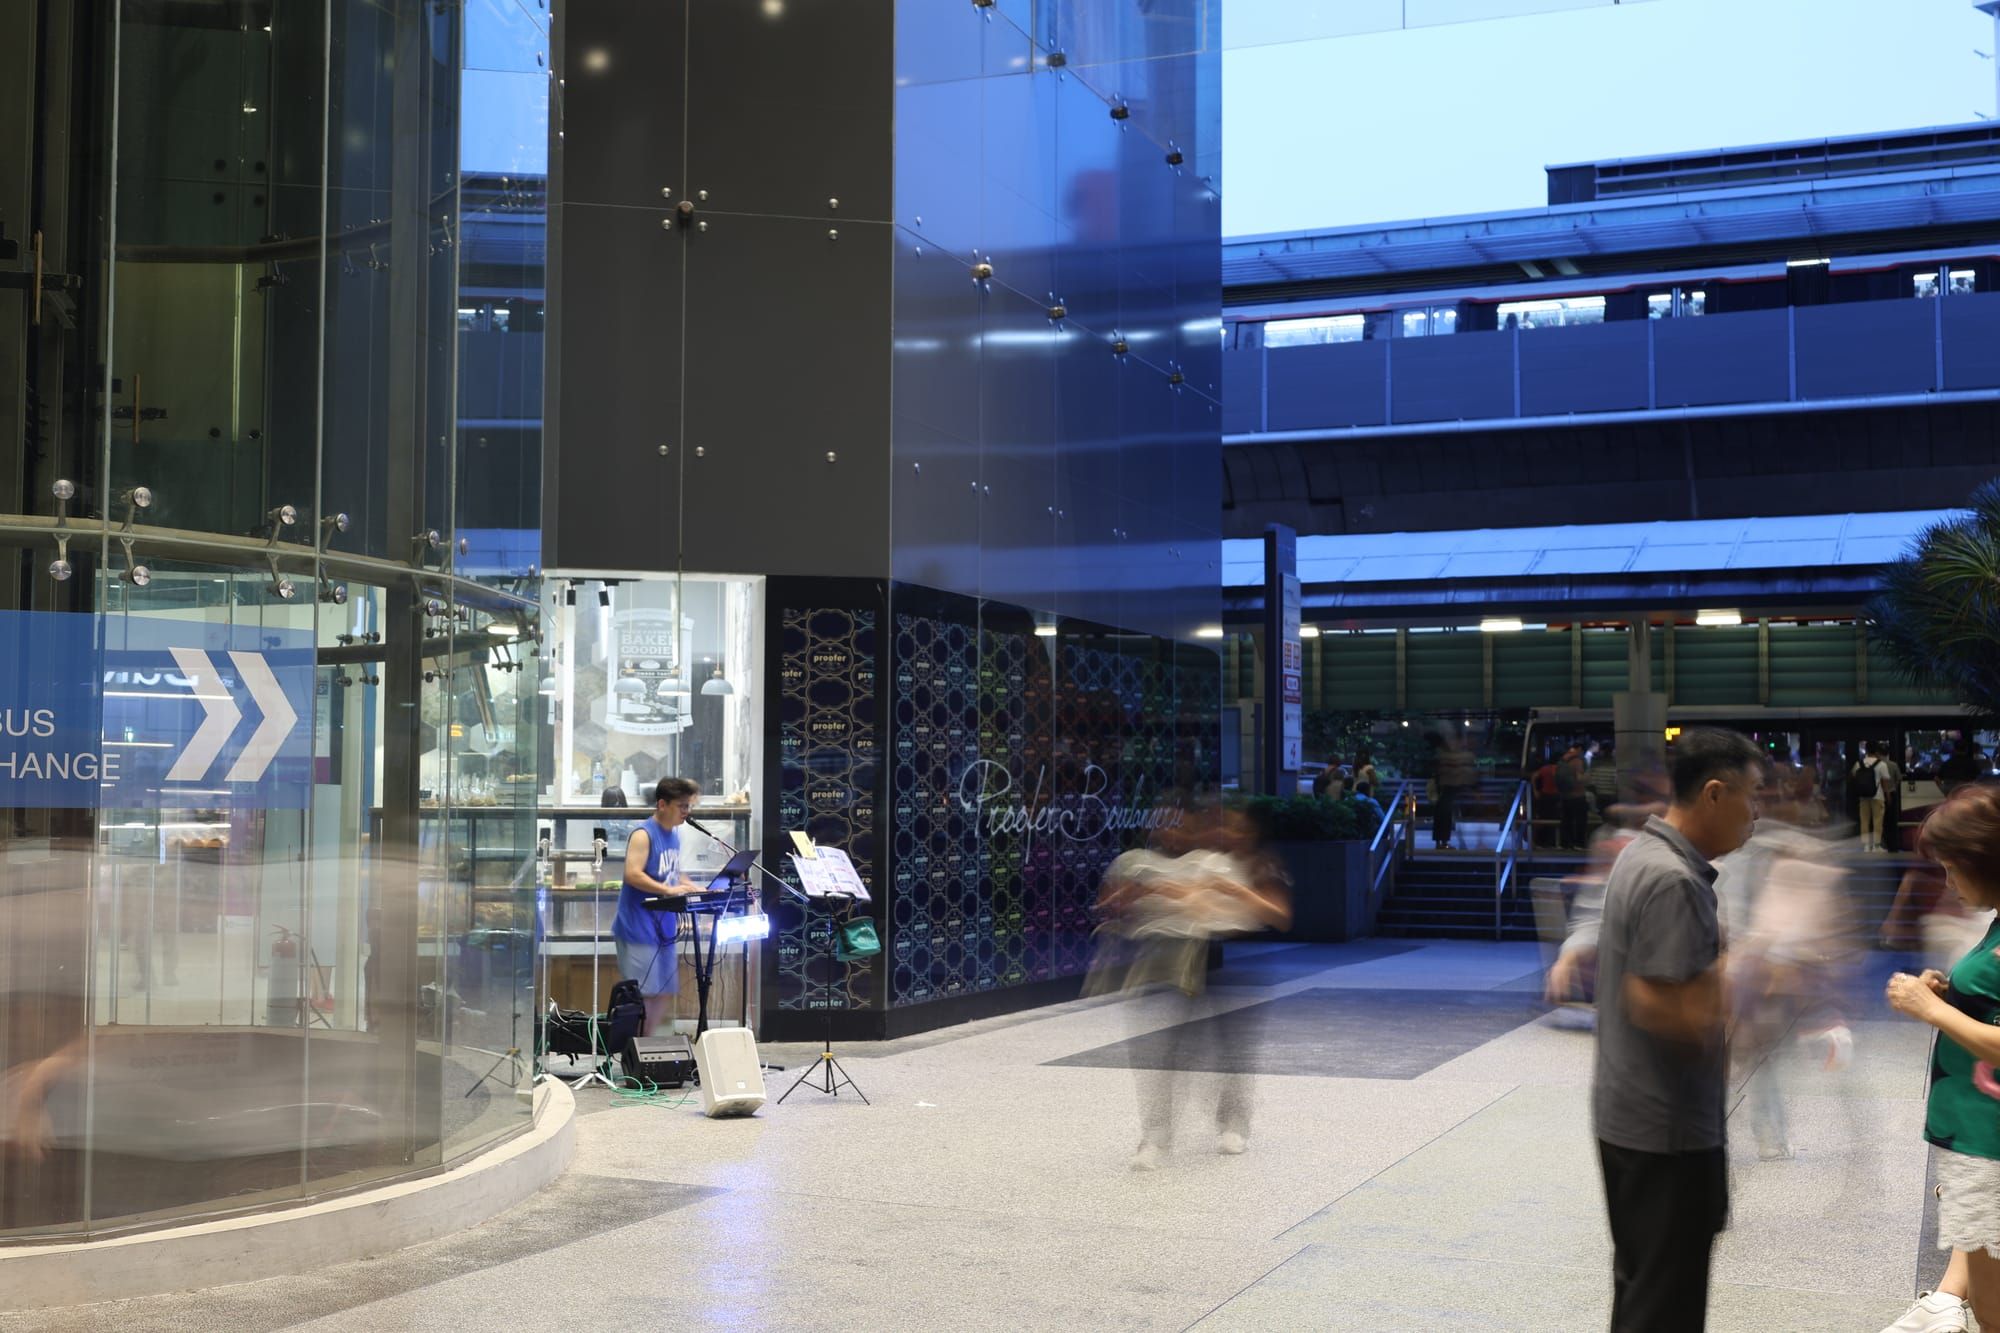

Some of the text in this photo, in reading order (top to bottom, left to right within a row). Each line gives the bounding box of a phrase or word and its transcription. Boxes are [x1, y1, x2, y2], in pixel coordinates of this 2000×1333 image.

[622, 634, 672, 646] BAKE
[621, 645, 672, 656] GOODIE
[813, 653, 846, 664] proofer
[0, 708, 55, 737] US
[812, 721, 846, 732] proofer
[811, 789, 845, 800] proofer
[959, 759, 1060, 864] Proofer
[861, 876, 872, 884] ro
